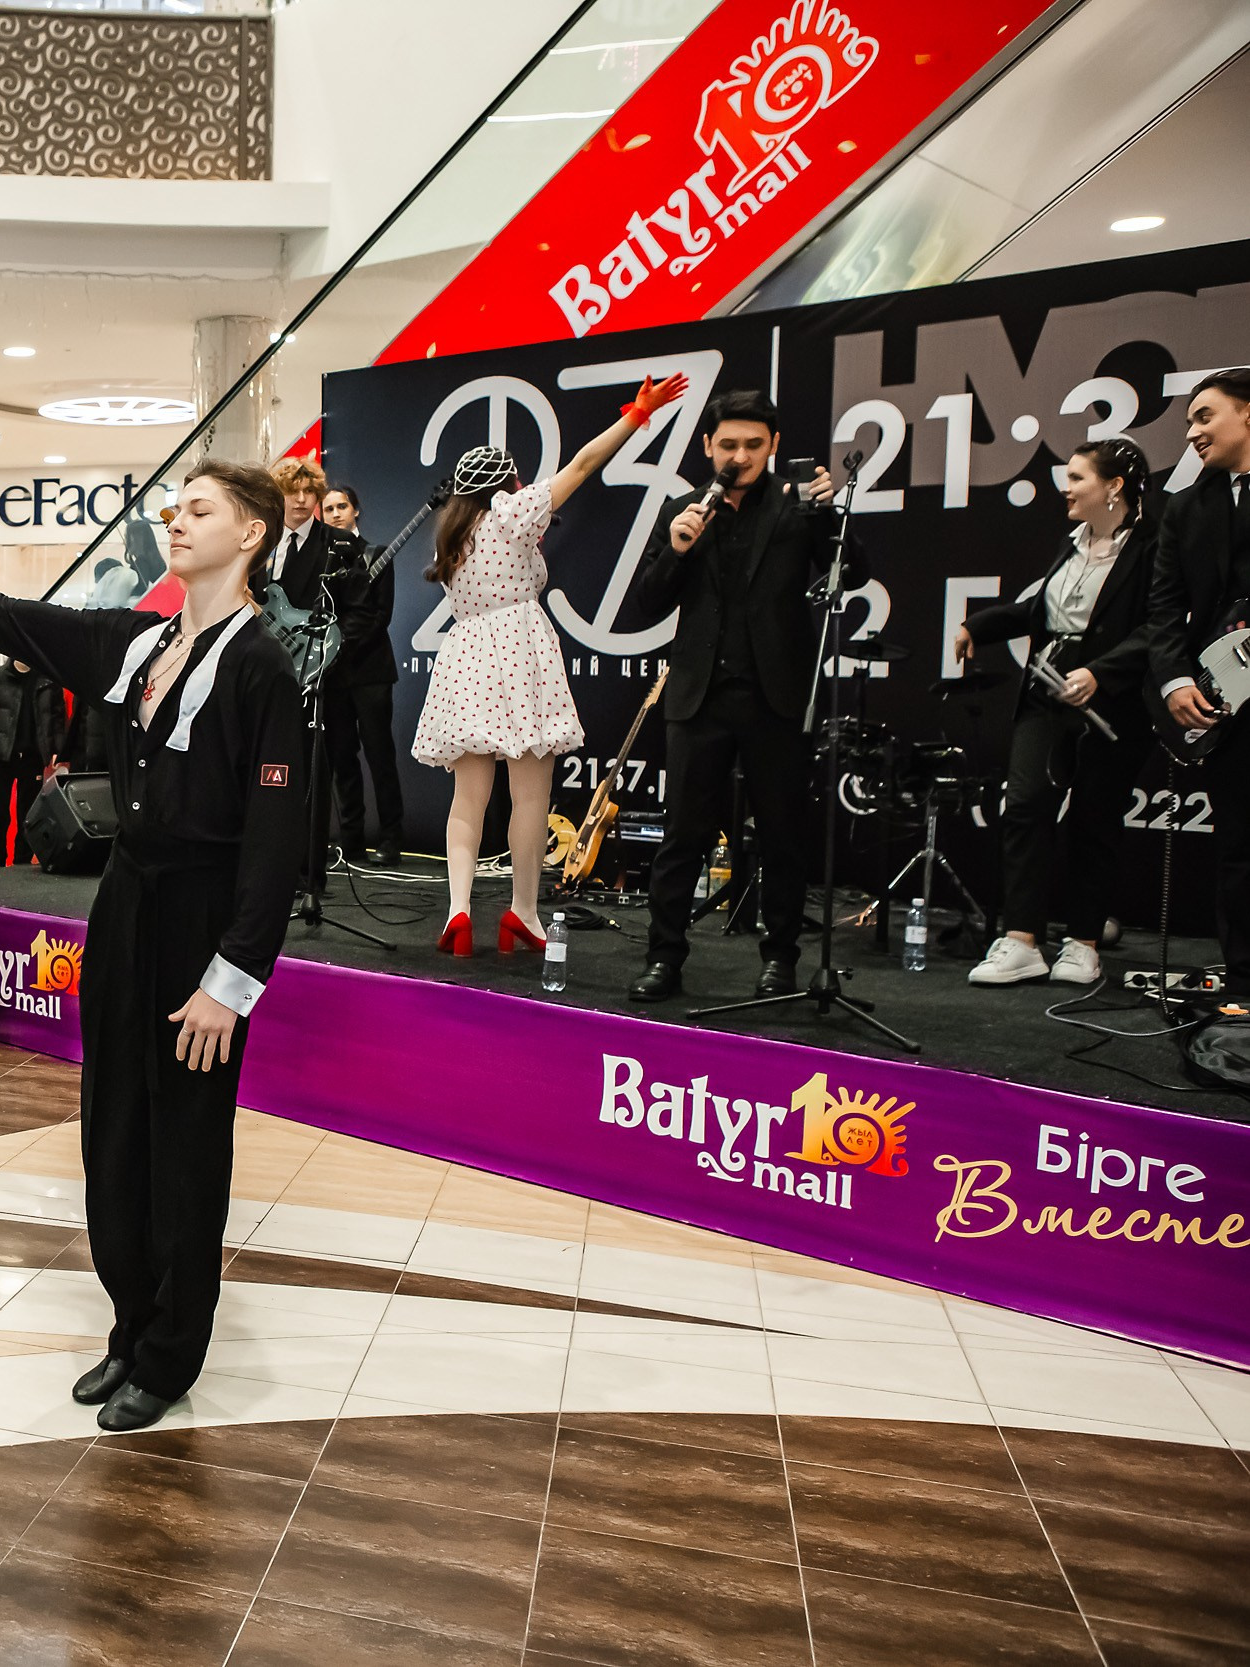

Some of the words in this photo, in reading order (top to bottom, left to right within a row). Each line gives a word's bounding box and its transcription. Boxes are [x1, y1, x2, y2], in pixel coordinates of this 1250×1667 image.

[714, 140, 812, 239] mall
[549, 158, 723, 339] Batyr
[15, 991, 61, 1020] mall
[599, 1053, 788, 1182] Batyr
[1037, 1124, 1206, 1203] Бірге
[752, 1160, 852, 1210] mall
[933, 1154, 1250, 1249] Вместе
